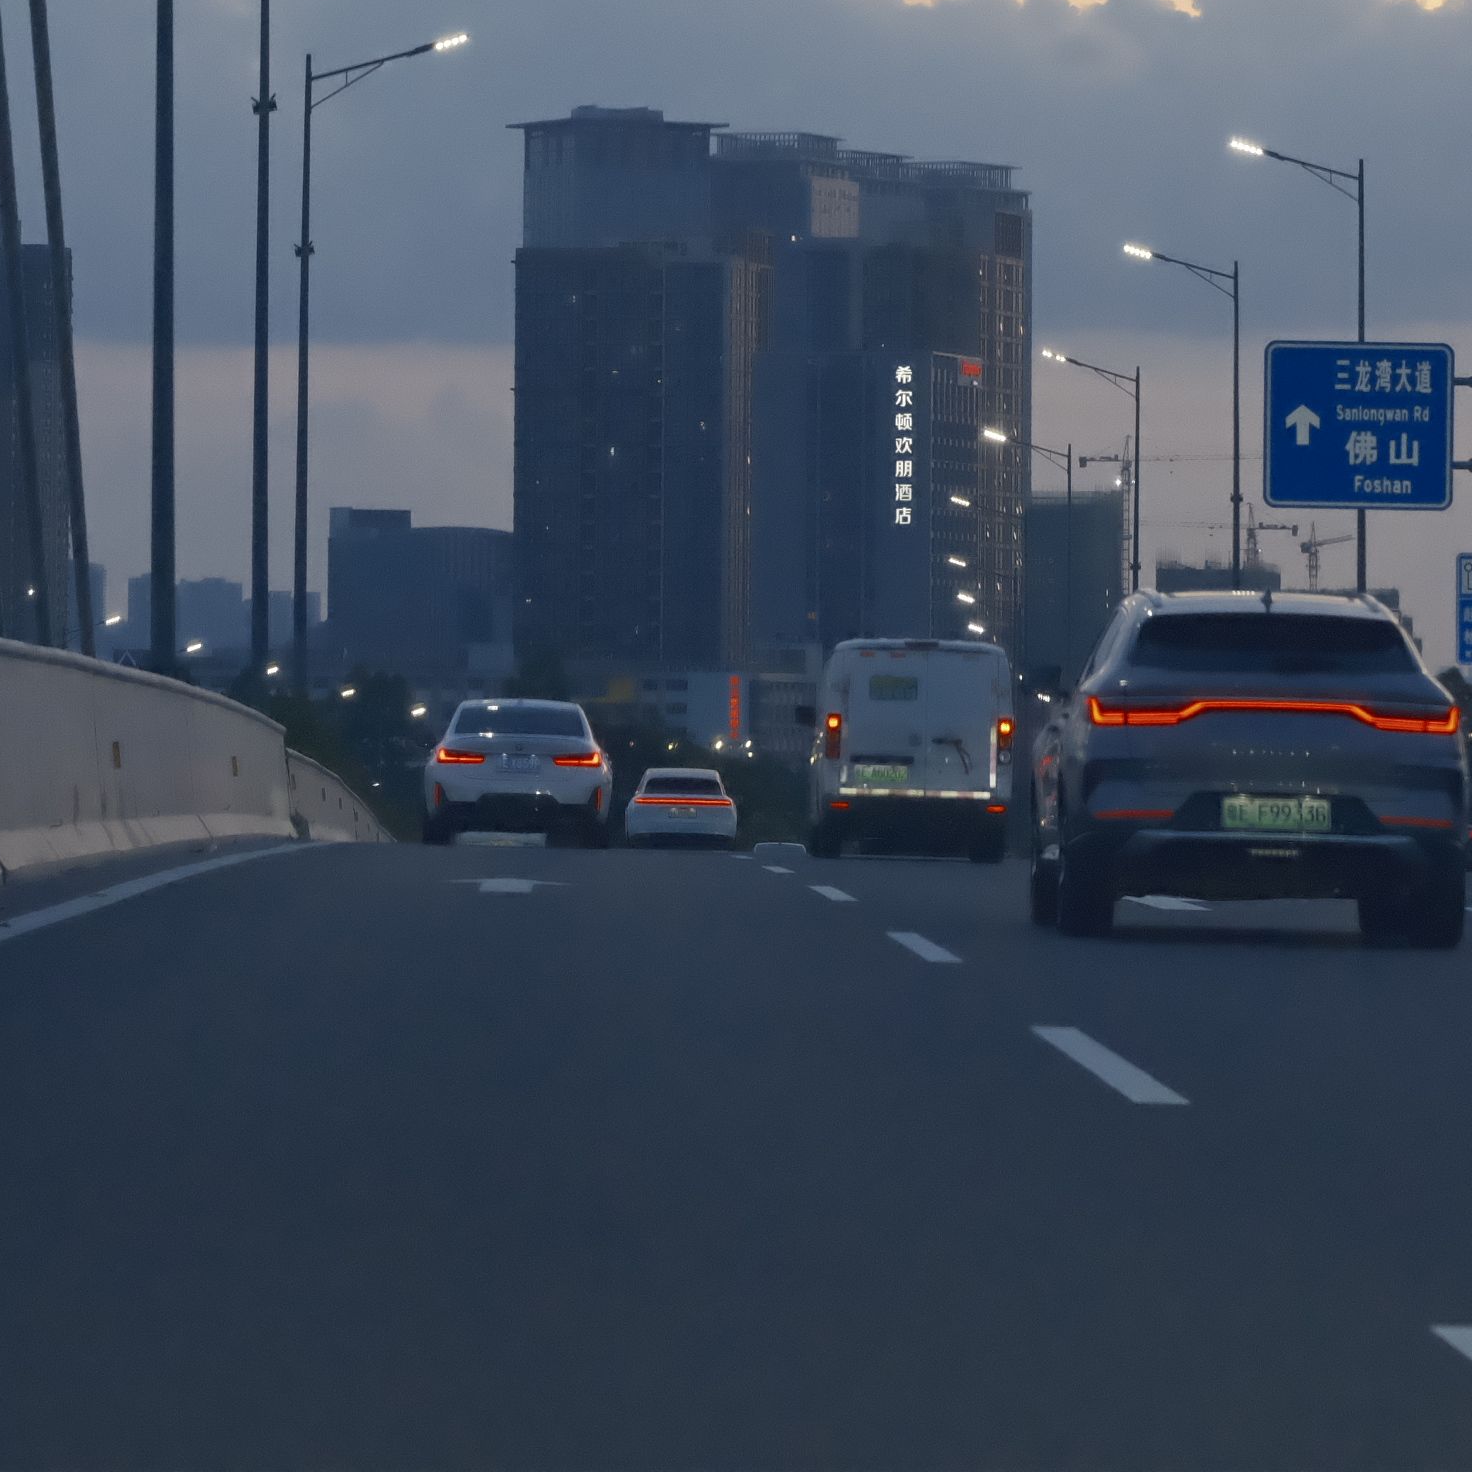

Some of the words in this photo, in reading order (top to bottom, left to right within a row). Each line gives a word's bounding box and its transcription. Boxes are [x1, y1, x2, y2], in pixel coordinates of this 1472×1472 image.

[1334, 359, 1432, 393] 三龙湾大道
[1336, 404, 1408, 426] Sanlongwan
[1414, 405, 1430, 422] Rd
[895, 366, 913, 525] 希尔顿欢朋酒店
[1345, 431, 1419, 466] 佛山
[1354, 476, 1412, 494] Foshan
